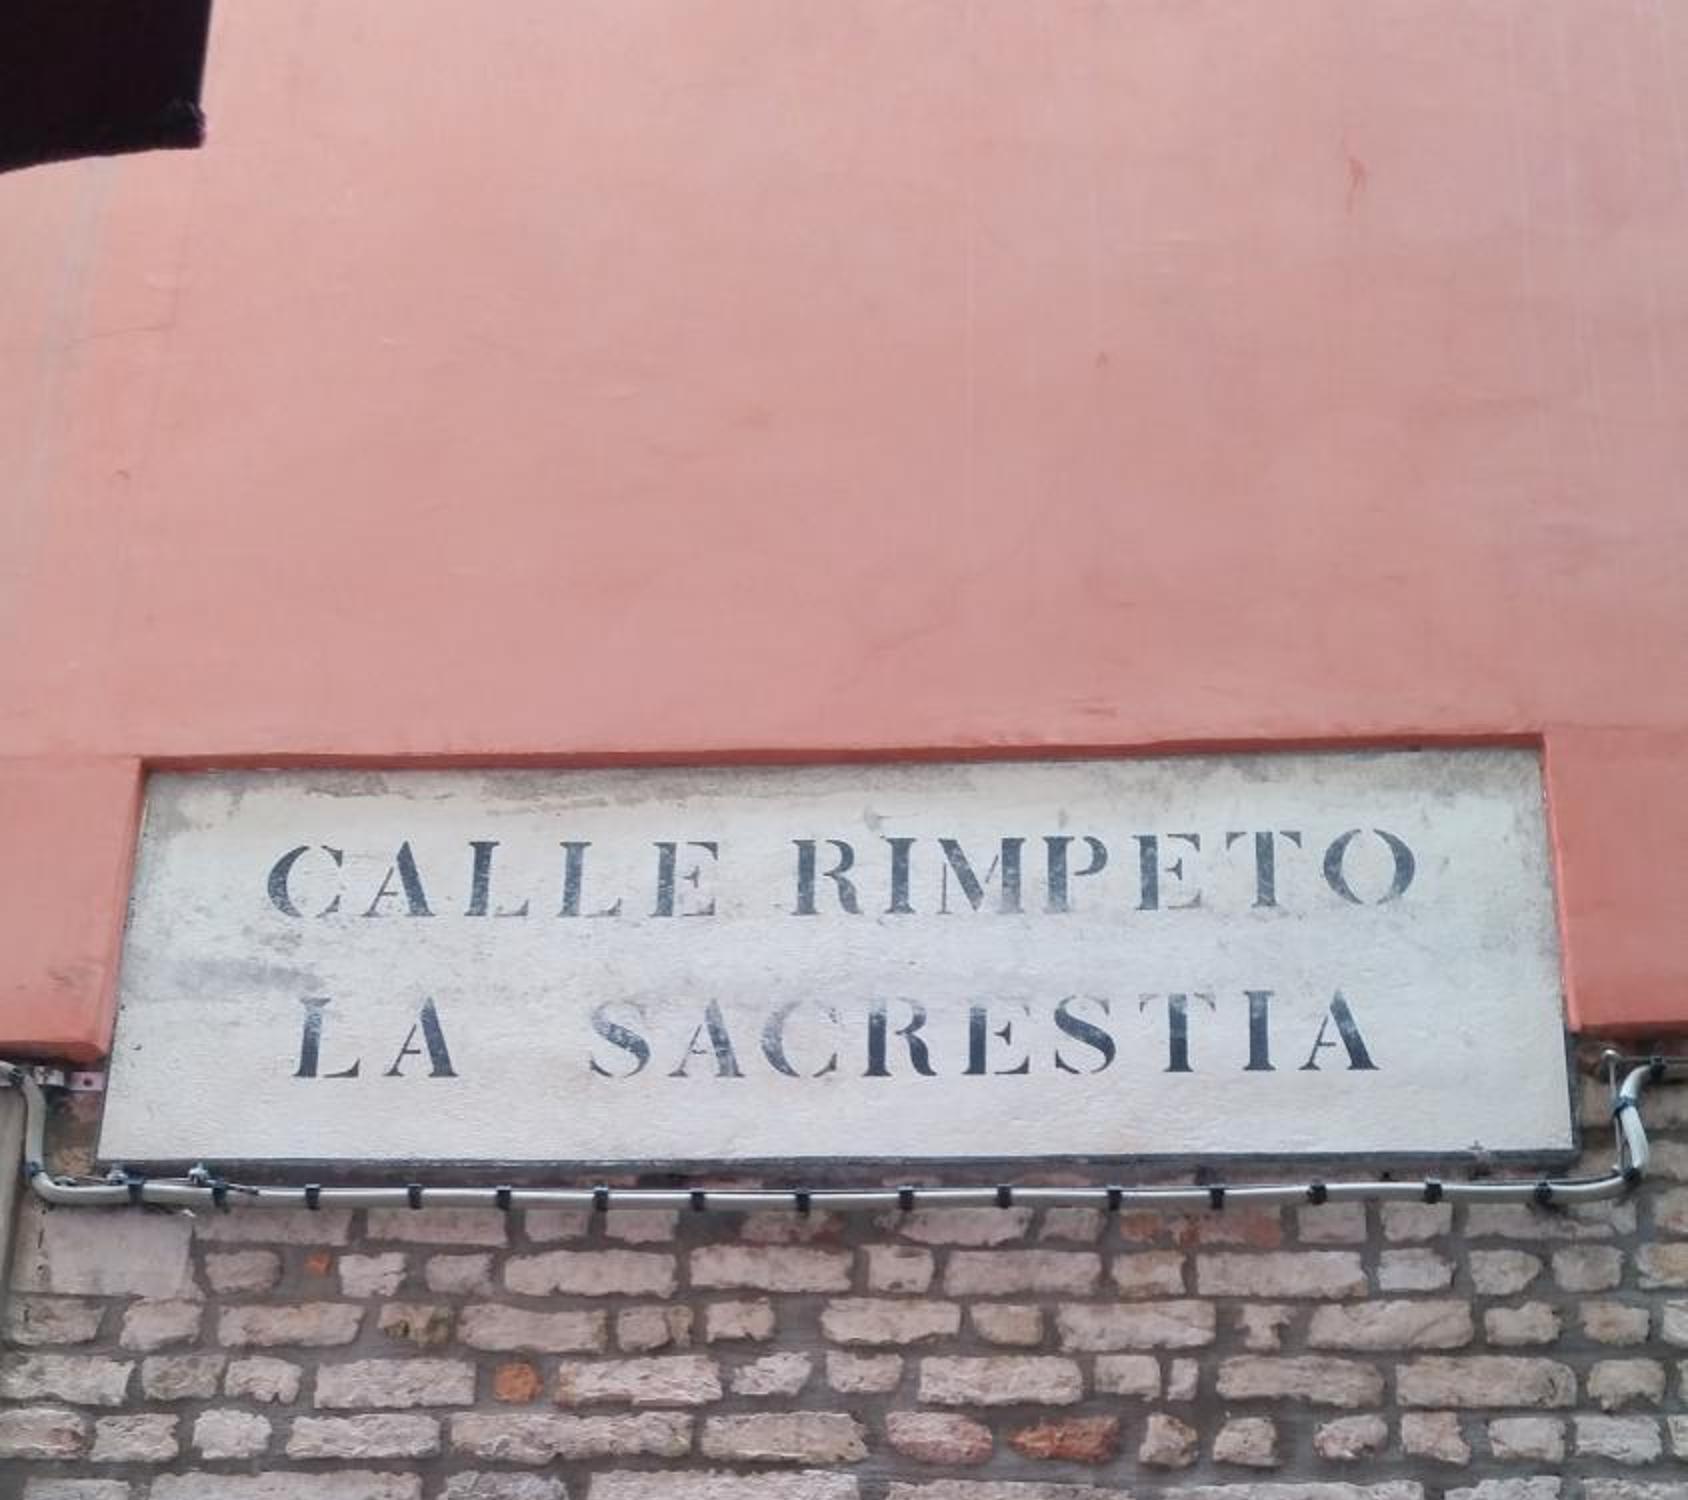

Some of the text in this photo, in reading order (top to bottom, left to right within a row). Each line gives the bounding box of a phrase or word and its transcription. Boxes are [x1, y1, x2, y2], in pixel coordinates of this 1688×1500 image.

[267, 829, 1416, 918] CALLE RIMPETO
[294, 990, 1382, 1079] LA SACRESTIA
